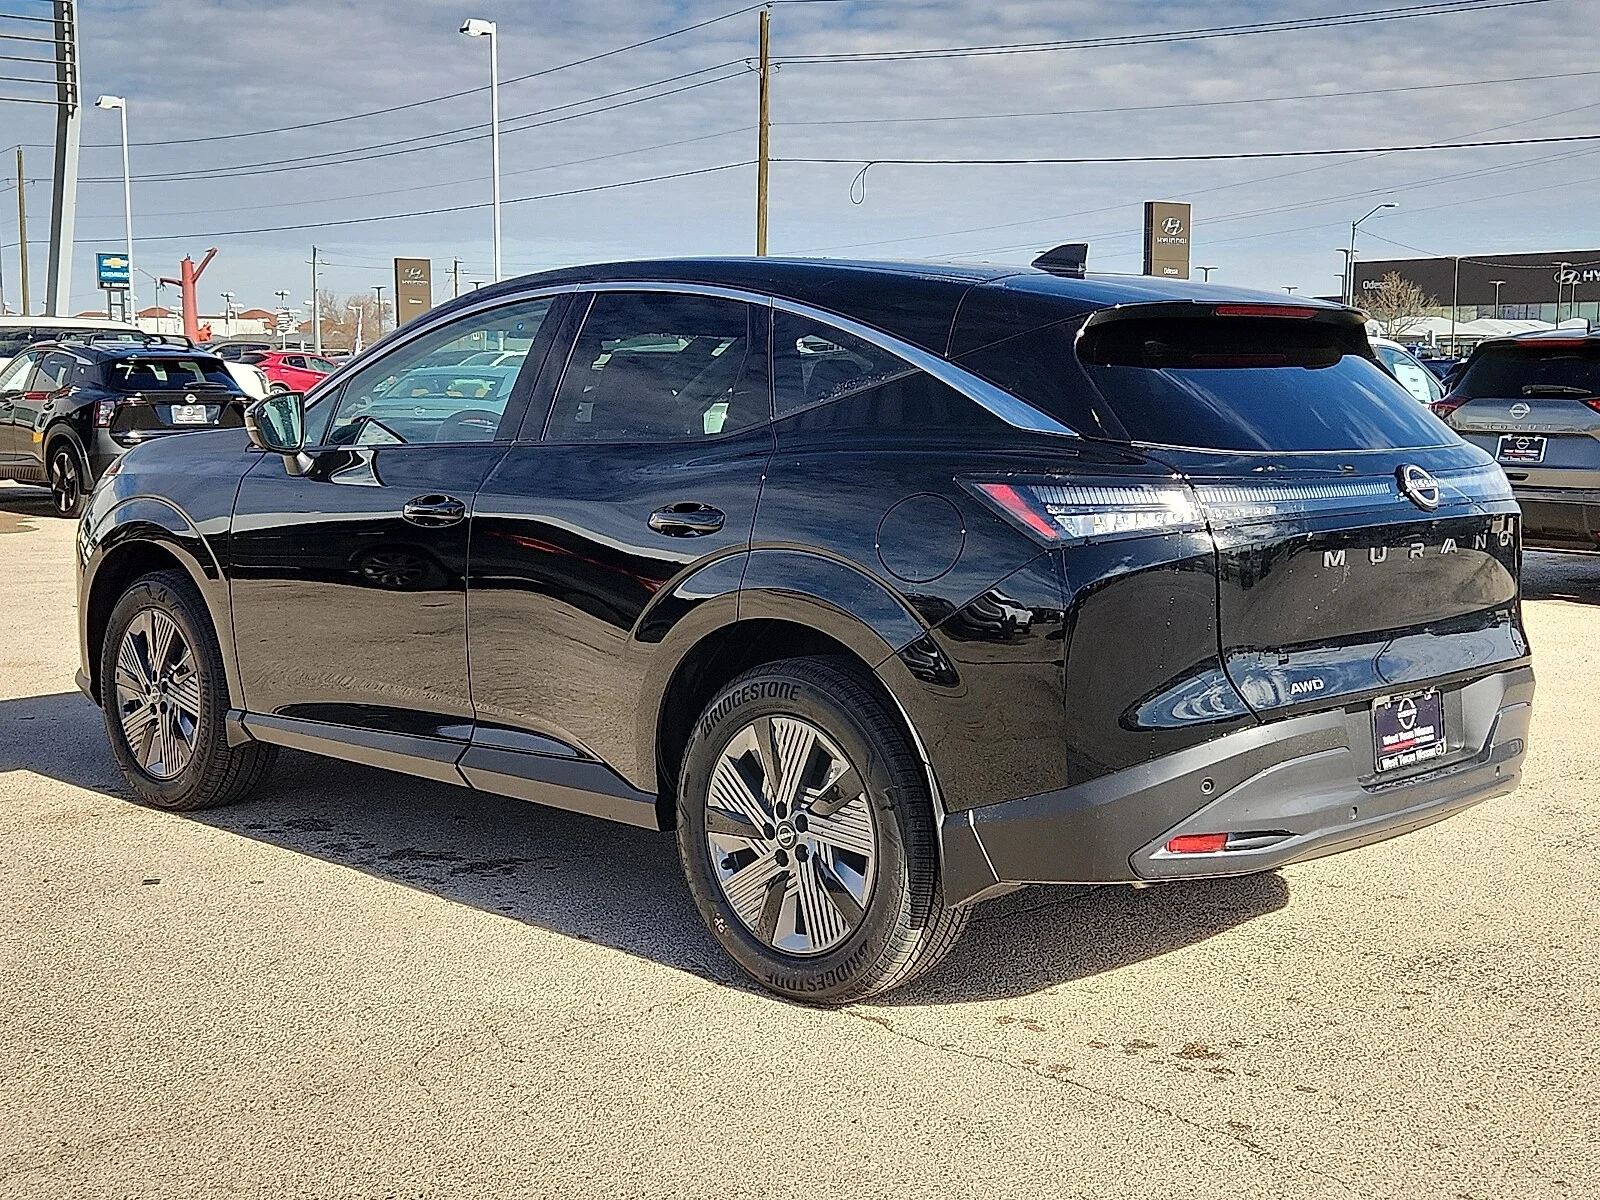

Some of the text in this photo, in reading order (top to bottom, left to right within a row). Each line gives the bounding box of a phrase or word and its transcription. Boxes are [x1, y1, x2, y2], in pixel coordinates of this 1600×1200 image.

[1322, 532, 1513, 568] MURANO
[1290, 678, 1324, 695] AWD
[700, 682, 802, 740] BRIDGESTONE
[1382, 747, 1436, 770] West Texas Nissan
